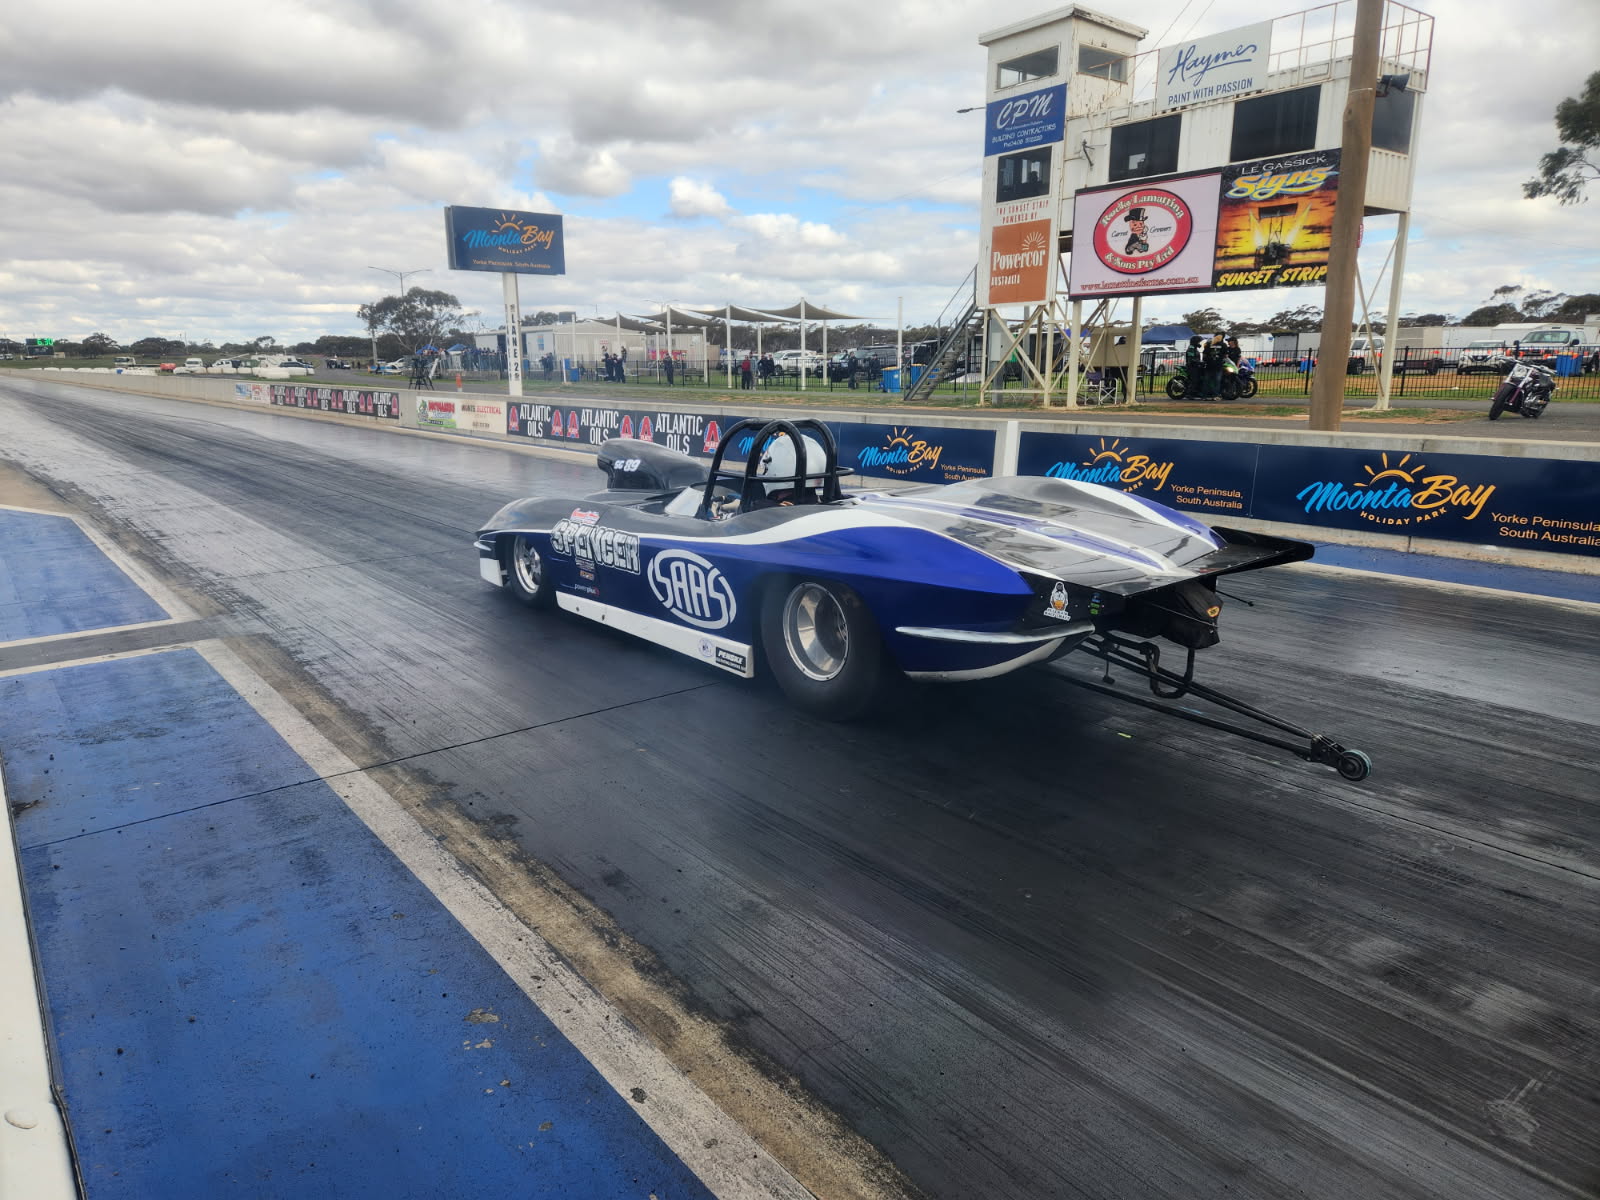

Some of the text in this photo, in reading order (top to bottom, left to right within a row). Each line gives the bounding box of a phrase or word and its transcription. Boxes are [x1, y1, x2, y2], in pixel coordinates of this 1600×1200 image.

[1168, 44, 1257, 87] Haymes
[1168, 78, 1253, 105] PAINT WITH PASSION
[997, 93, 1053, 129] CPM
[1017, 123, 1056, 138] CONTRACTORS
[1242, 155, 1327, 175] LE GASSICK
[1225, 165, 1340, 200] Signs
[1008, 203, 1029, 214] SUNSET
[1032, 200, 1049, 210] STRIP
[1101, 200, 1132, 228] Rocky
[1003, 213, 1027, 224] POWERED
[463, 225, 554, 249] Moonta Bay
[992, 250, 1046, 271] Powercor
[1138, 258, 1155, 269] Pty
[1155, 246, 1175, 264] Ltd
[991, 274, 1020, 286] AUSTRALIA
[1217, 265, 1328, 287] SUNSET STRIP
[514, 363, 519, 371] 2
[520, 404, 551, 422] ATLANTIC
[580, 409, 619, 428] ATLANTIC
[527, 420, 543, 437] OILS
[655, 413, 703, 436] ATLANTIC
[590, 428, 609, 445] OILS
[666, 436, 690, 455] OILS
[857, 440, 943, 470] Moonta Bay
[624, 459, 641, 472] 89
[1045, 455, 1174, 491] Moonta Bay
[944, 472, 961, 480] South
[1170, 484, 1243, 499] Yorke Peninsula,
[1296, 475, 1496, 520] Moonta Bay
[1176, 495, 1243, 510] South Australia
[1360, 507, 1448, 525] HOLIDAY PARK
[1491, 512, 1528, 525] Yorke
[1499, 526, 1600, 547] South Australia
[551, 519, 641, 575] SPENCER
[650, 550, 734, 629] SAAS
